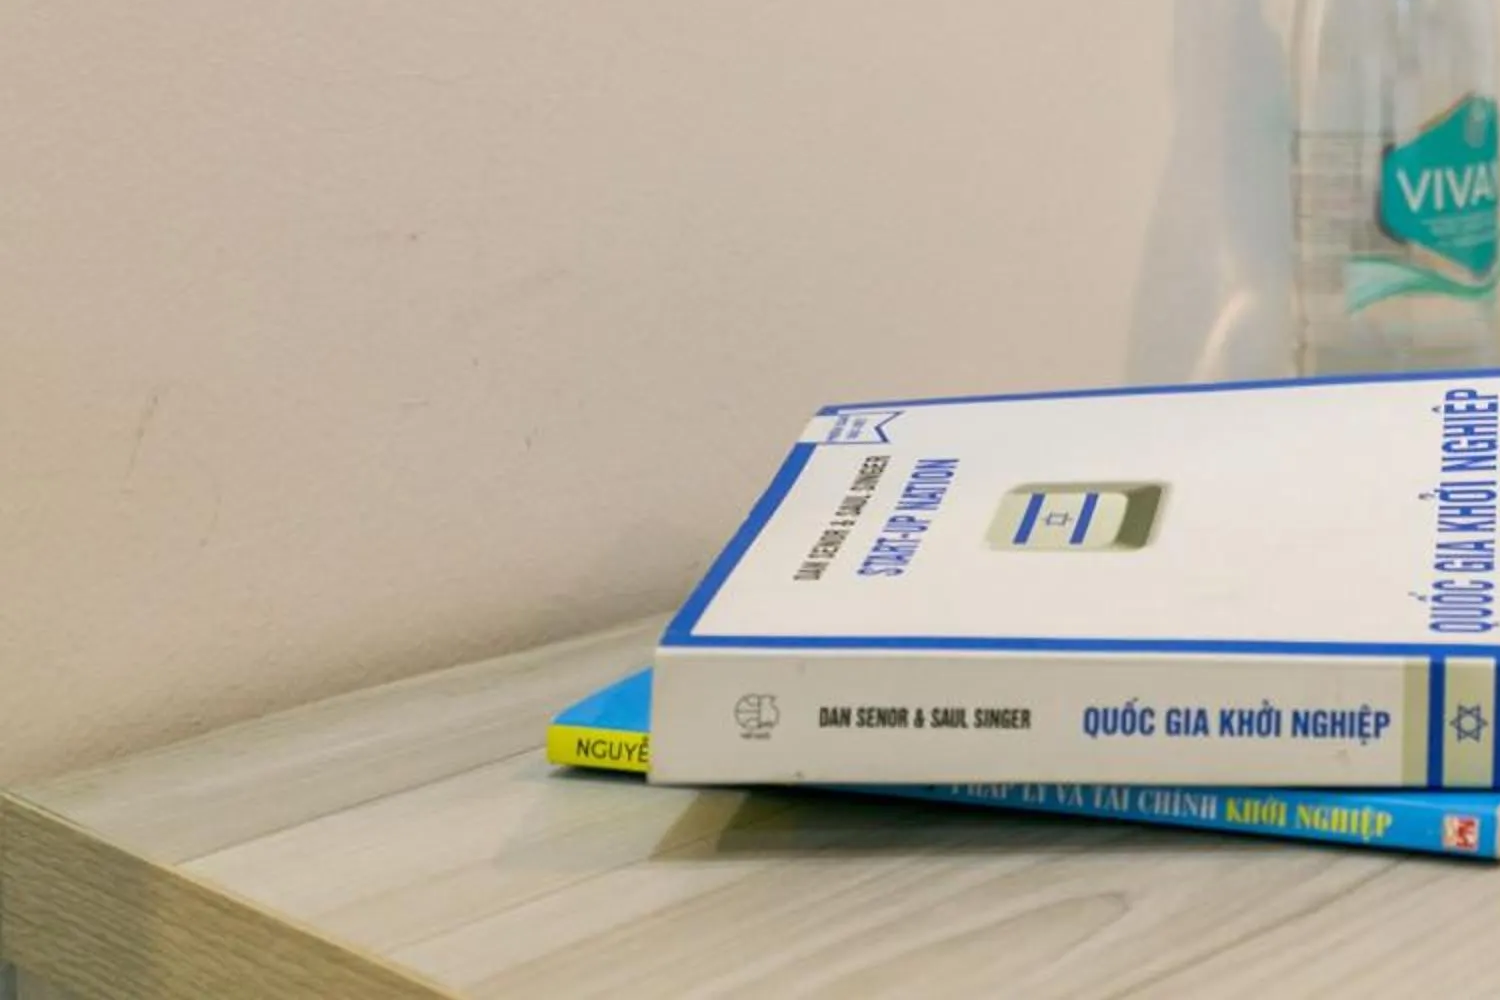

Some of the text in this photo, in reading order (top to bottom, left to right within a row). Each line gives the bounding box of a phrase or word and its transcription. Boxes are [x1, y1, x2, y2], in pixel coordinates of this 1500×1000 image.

[857, 458, 960, 576] START-UP NATION
[1418, 480, 1497, 533] KHỞI
[1433, 539, 1495, 573] GIA
[1407, 579, 1500, 633] QUỐC
[819, 708, 1032, 729] DAN SENOR & SAUL SINGER
[1083, 698, 1391, 746] QUỐC GIA KHỞI NGHIỆP
[1295, 804, 1392, 843] NGHIỆP
